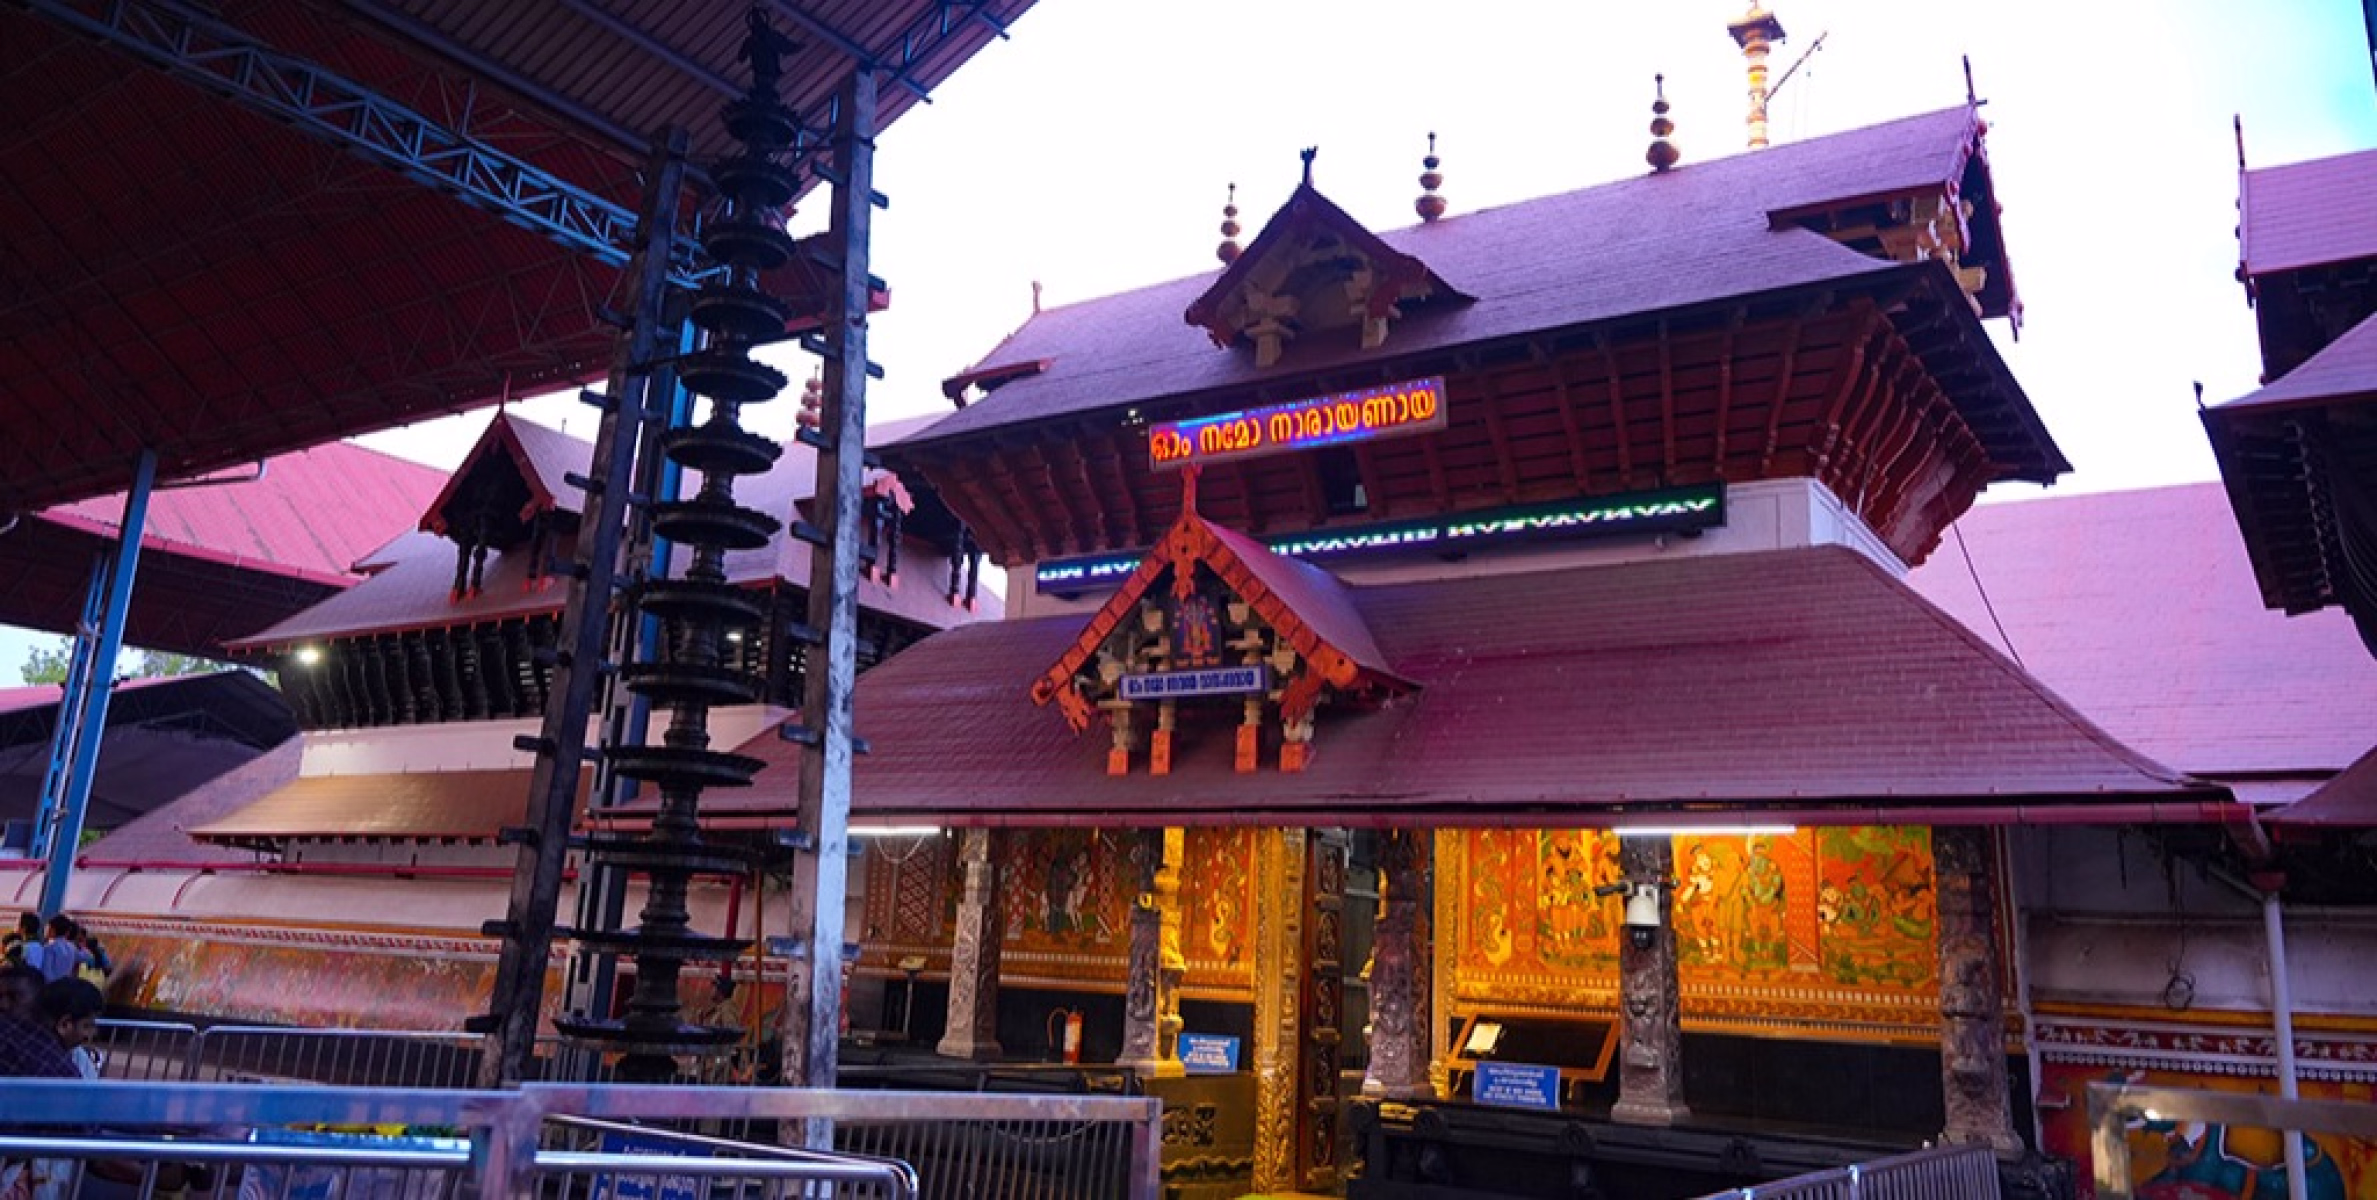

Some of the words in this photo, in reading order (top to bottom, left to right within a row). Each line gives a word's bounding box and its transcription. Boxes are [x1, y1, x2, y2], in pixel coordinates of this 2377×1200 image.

[1151, 430, 1192, 461] ഓം
[1200, 417, 1262, 455] നമോ
[1269, 389, 1436, 445] നാരായണായ
